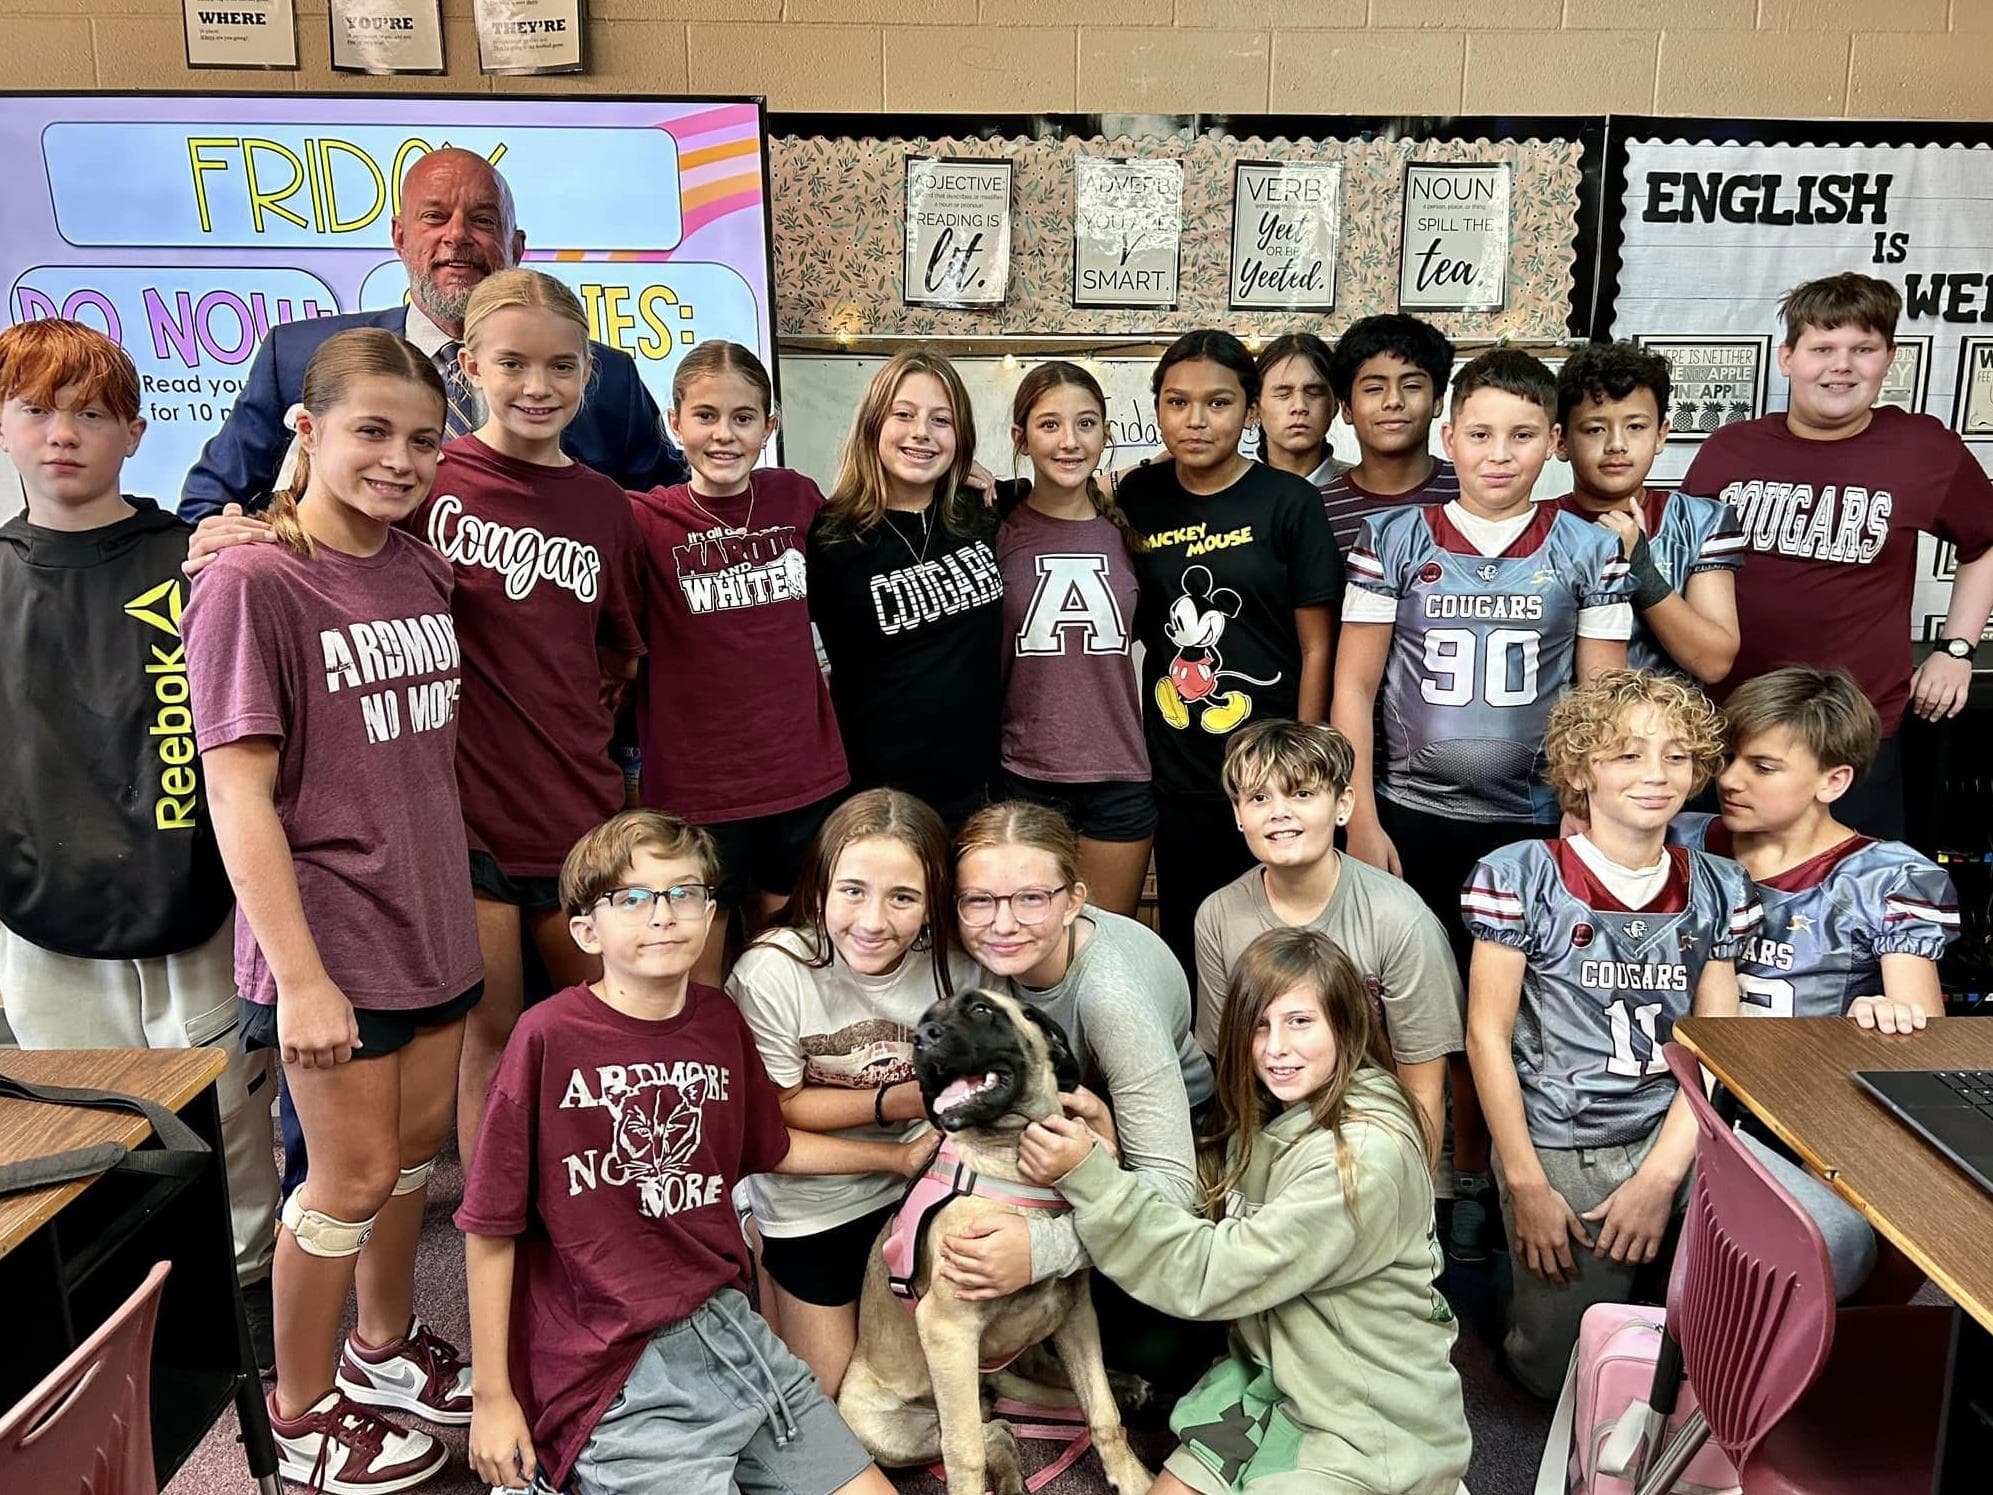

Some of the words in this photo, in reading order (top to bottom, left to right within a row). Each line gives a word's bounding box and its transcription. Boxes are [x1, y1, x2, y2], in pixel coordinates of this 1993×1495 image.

[198, 12, 266, 25] WHERE
[345, 16, 414, 30] YOU'RE
[492, 19, 566, 34] THEY'RE
[1642, 172, 1893, 226] ENGLISH
[917, 212, 983, 226] READING
[987, 214, 1000, 227] IS
[1417, 217, 1459, 232] SPILL
[1463, 217, 1494, 232] THE
[1266, 246, 1283, 257] OR
[1872, 231, 1910, 264] IS
[1082, 269, 1170, 291] SMART.
[1414, 238, 1484, 292] tea.
[142, 288, 333, 368] NOW
[1688, 349, 1700, 364] IS
[1702, 349, 1753, 364] NEITHER
[144, 374, 201, 393] Read
[1707, 367, 1752, 381] APPLE
[151, 403, 179, 421] for
[188, 403, 213, 421] 10
[1104, 396, 1162, 445] rida
[428, 494, 601, 603] Cougars
[687, 531, 706, 544] It's
[706, 526, 723, 540] all
[1185, 525, 1254, 558] MOUSE
[718, 561, 753, 579] AND
[680, 565, 791, 614] WHITE
[870, 540, 1003, 635] COUGARS
[1016, 553, 1128, 657] A
[1424, 594, 1544, 621] COUGARS
[320, 613, 461, 693] ARDMOR
[1420, 627, 1543, 708] 90
[360, 689, 401, 744] NO
[407, 677, 462, 734] MORE
[145, 643, 197, 830] Reebok
[1580, 959, 1689, 992] COUGARS
[1603, 998, 1672, 1079] 11
[558, 1061, 731, 1109] ARDMORE
[561, 1149, 629, 1197] NO
[636, 1172, 725, 1219] MORE
